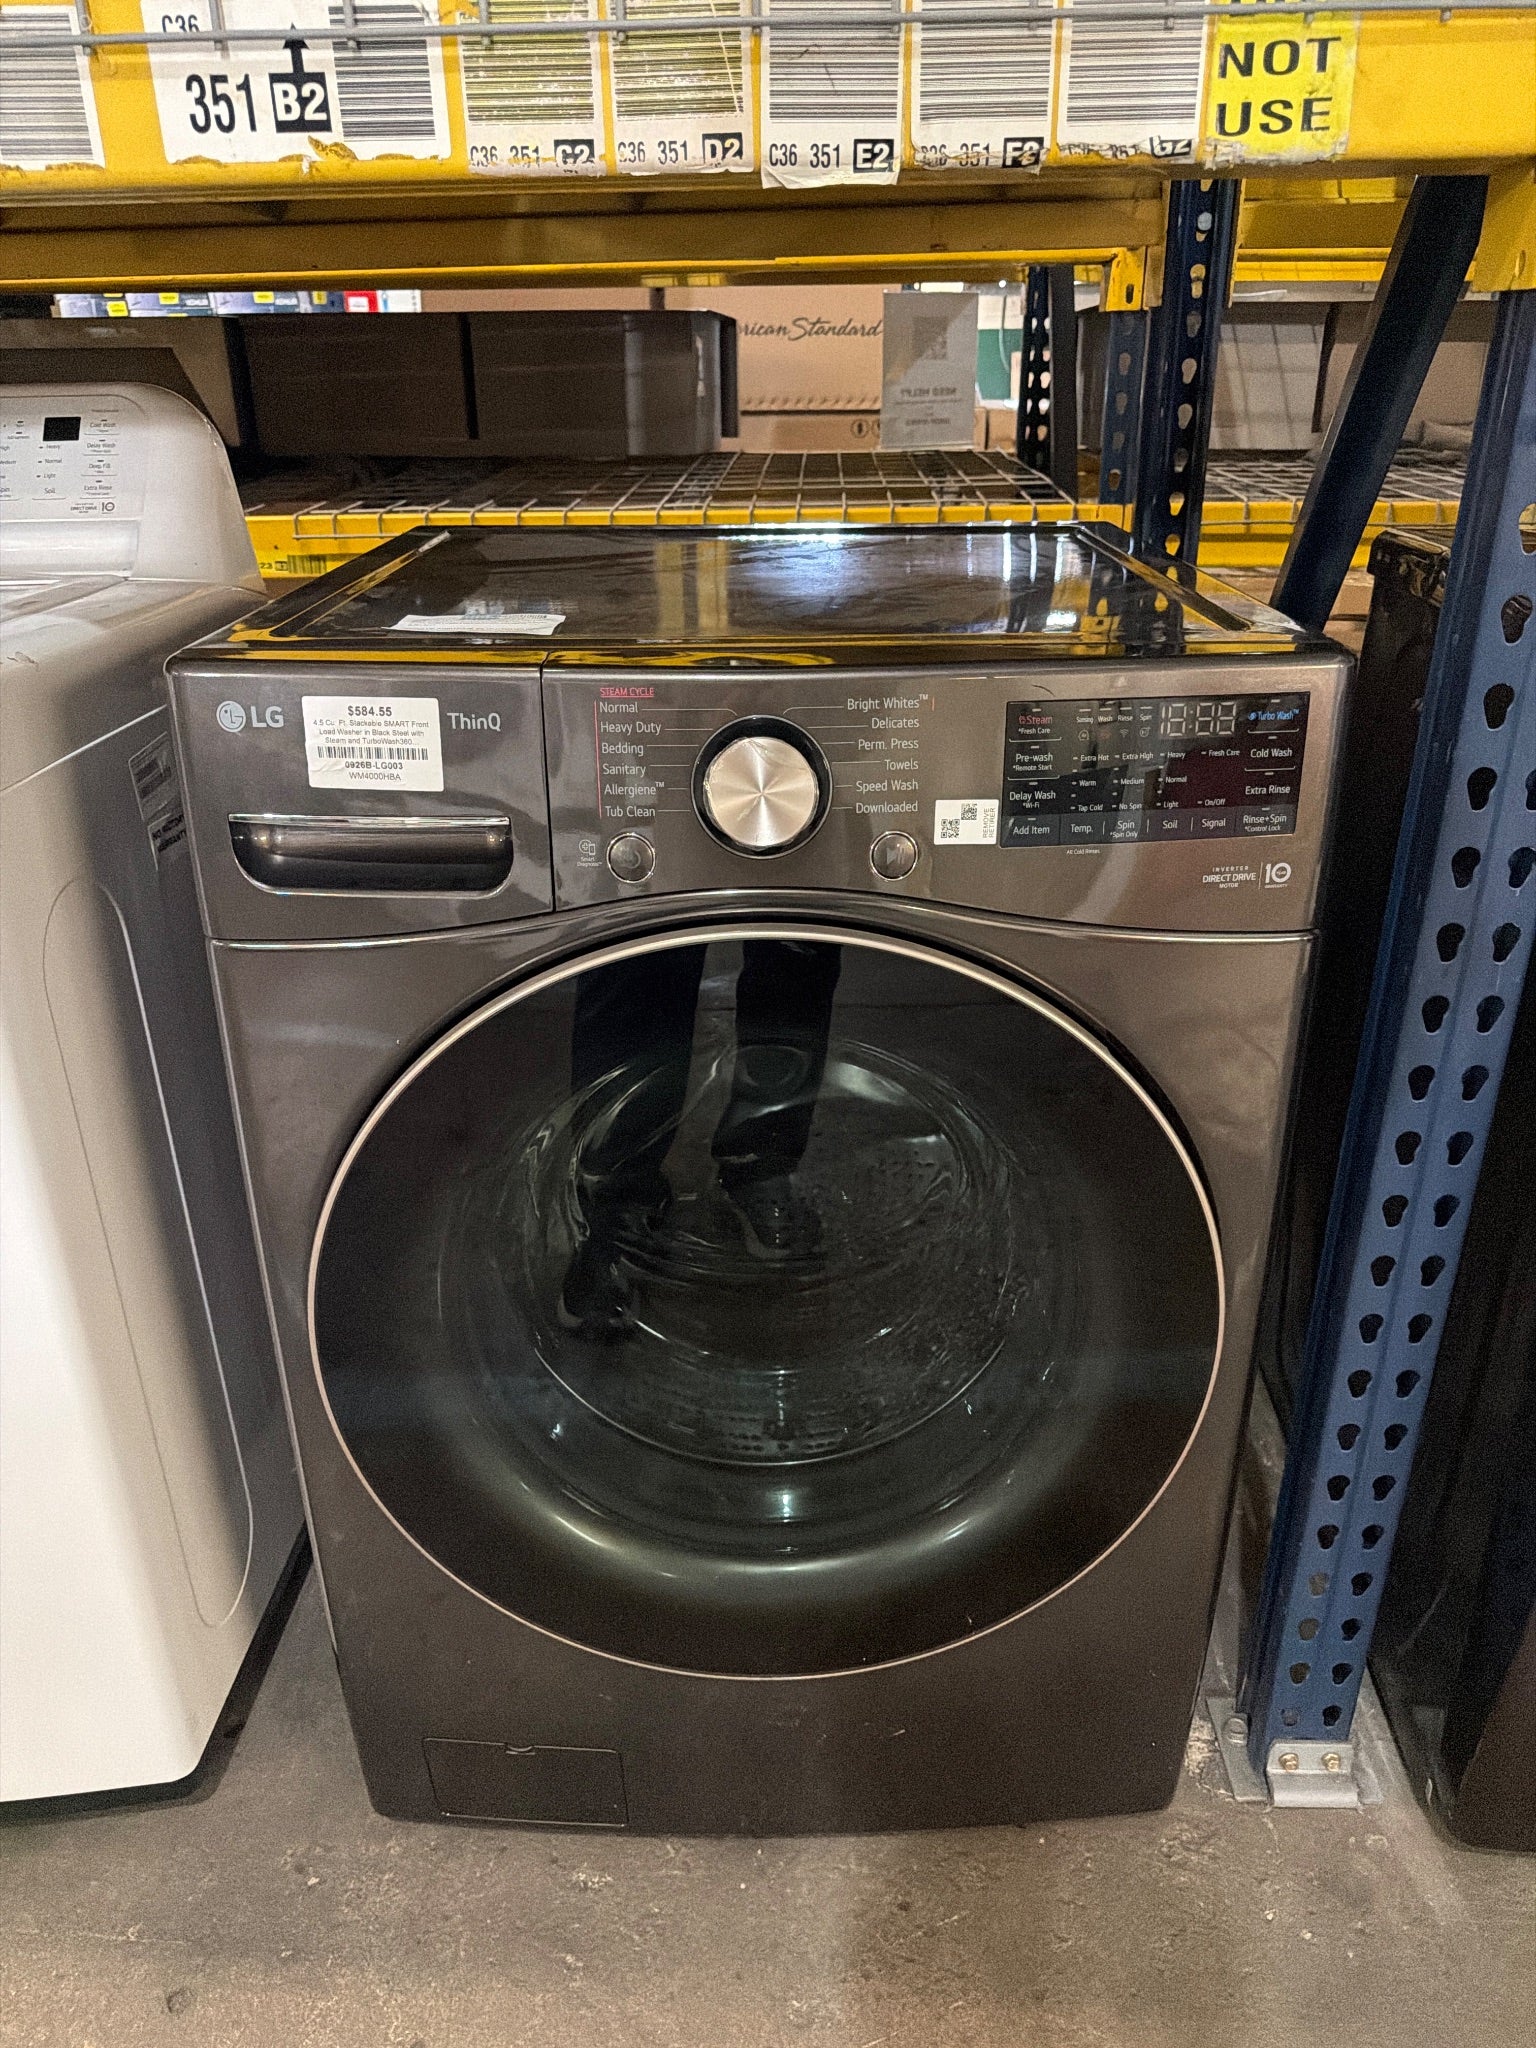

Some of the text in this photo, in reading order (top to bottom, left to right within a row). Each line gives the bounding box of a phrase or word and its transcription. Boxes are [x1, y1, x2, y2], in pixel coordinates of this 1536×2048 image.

[1218, 36, 1342, 78] NOT
[186, 74, 329, 134] 351 B2
[1215, 97, 1333, 137] USE
[618, 138, 742, 165] C36 351 D2
[769, 142, 891, 169] C36 351 E2
[788, 316, 882, 341] Standard
[600, 687, 655, 696] STEAM CYCLE
[600, 701, 639, 712] Normal
[847, 697, 881, 712] Bright
[250, 705, 285, 728] LG
[347, 705, 392, 717] $584.55
[349, 719, 382, 727] Stackable
[446, 712, 501, 732] ThinQ
[600, 720, 661, 736] Heavy Duty
[871, 717, 920, 730] Delicates
[336, 728, 363, 736] Washer
[371, 729, 391, 737] Black
[601, 742, 645, 757] Bedding
[858, 737, 920, 751] Perm. Press
[1015, 751, 1054, 763] Pre-wash
[1121, 751, 1154, 760] Extra High
[1167, 751, 1186, 759] Heavy
[1208, 749, 1225, 757] Fresh
[1250, 748, 1294, 758] Cold Wash
[344, 760, 404, 769] 0926B-LG003
[602, 763, 646, 778] Sanitary
[884, 759, 919, 771] Towels
[349, 771, 403, 780] WM4000HBA
[1120, 777, 1145, 785] Medium
[1165, 775, 1188, 783] Normal
[855, 778, 919, 795] Speed Wash
[1078, 779, 1097, 787] Warm
[1244, 784, 1291, 794] Extra Rinse
[1009, 789, 1057, 803] Delay Wash
[1204, 797, 1226, 806] On/Off
[855, 800, 919, 814] Downloaded
[1078, 804, 1089, 812] Tap
[1129, 802, 1143, 810] Spin
[1163, 800, 1179, 809] Light
[604, 805, 656, 817] Tub Clean
[982, 807, 990, 838] REMOVE
[1070, 822, 1094, 835] Temp.
[1117, 819, 1136, 832] Spin
[1162, 818, 1179, 830] Soil
[1201, 817, 1226, 830] Signal
[1013, 824, 1051, 836] Add Item
[1125, 830, 1139, 838] Only
[1202, 873, 1232, 882] DIRECT
[1232, 872, 1257, 881] DRIVE
